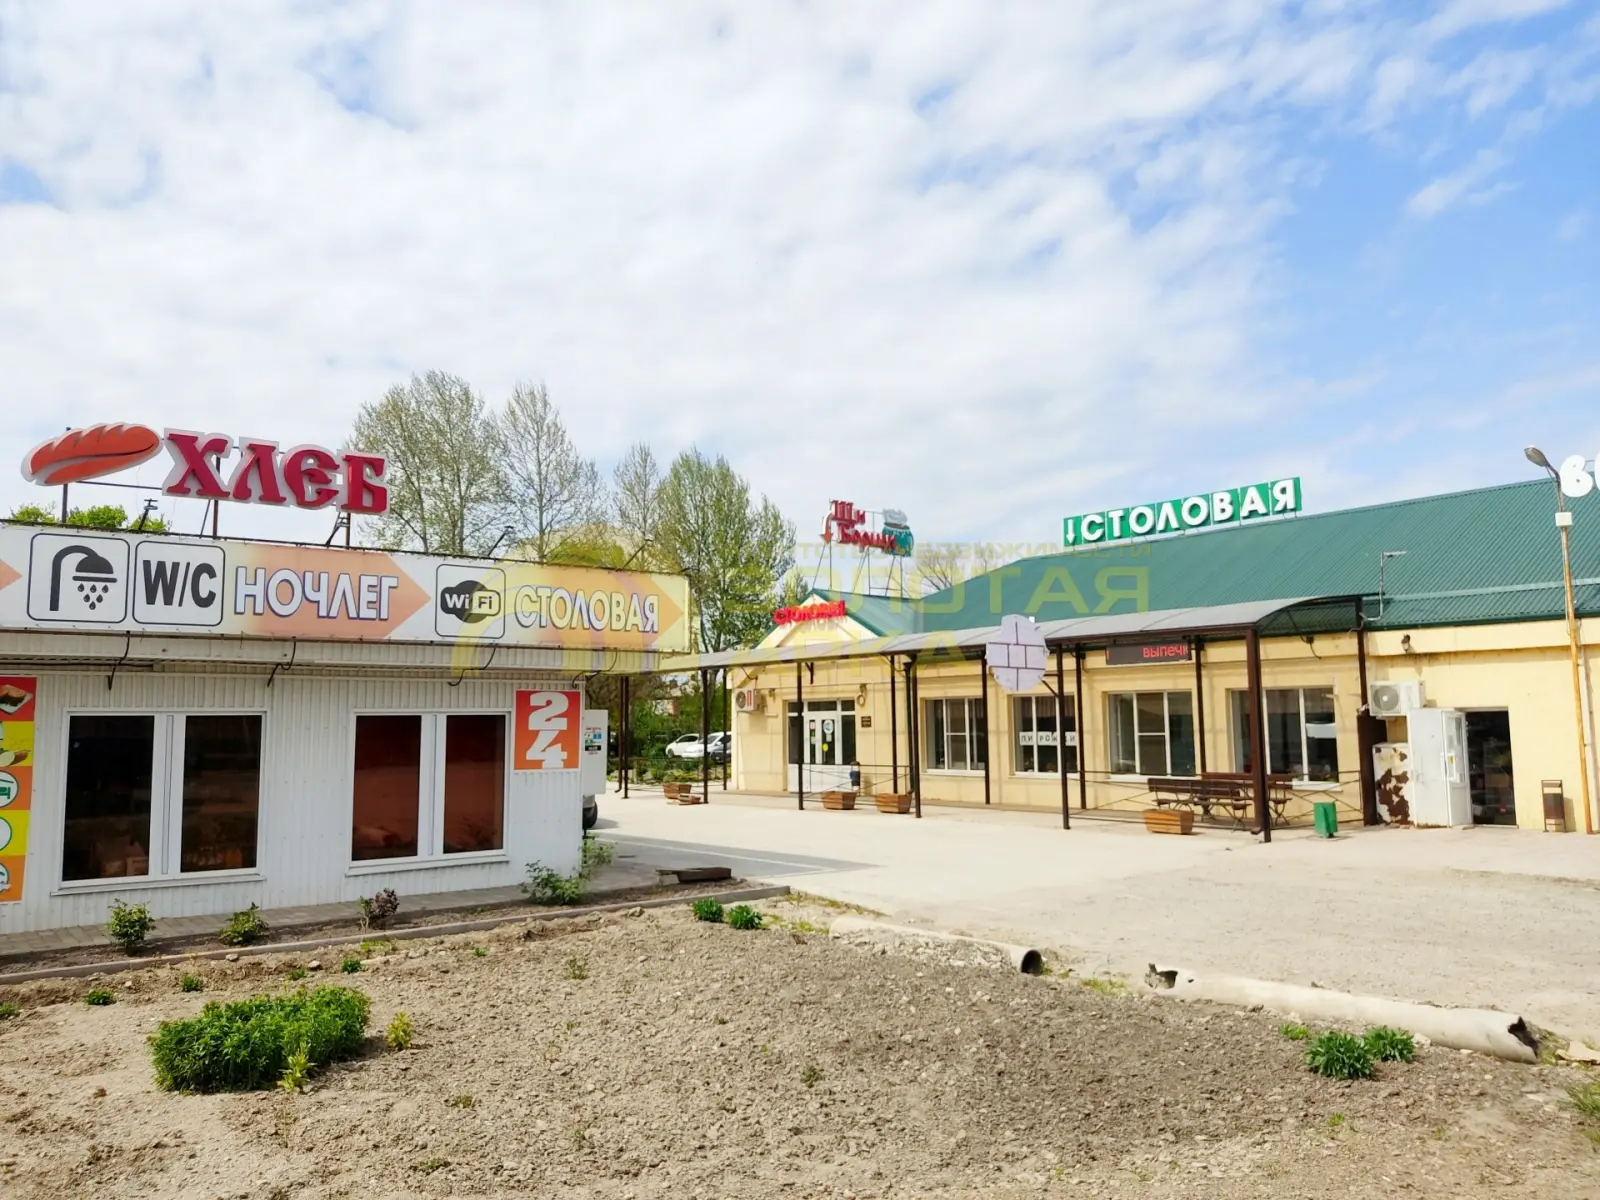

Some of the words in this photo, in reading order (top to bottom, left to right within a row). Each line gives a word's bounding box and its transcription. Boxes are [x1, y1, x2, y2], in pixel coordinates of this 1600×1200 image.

[165, 432, 388, 513] ХЛЕБ
[1081, 479, 1296, 541] СТОЛОВАЯ
[142, 559, 217, 609] W/C
[233, 566, 399, 621] НОЧЛЕГ
[514, 585, 660, 633] СТОЛОВАЯ
